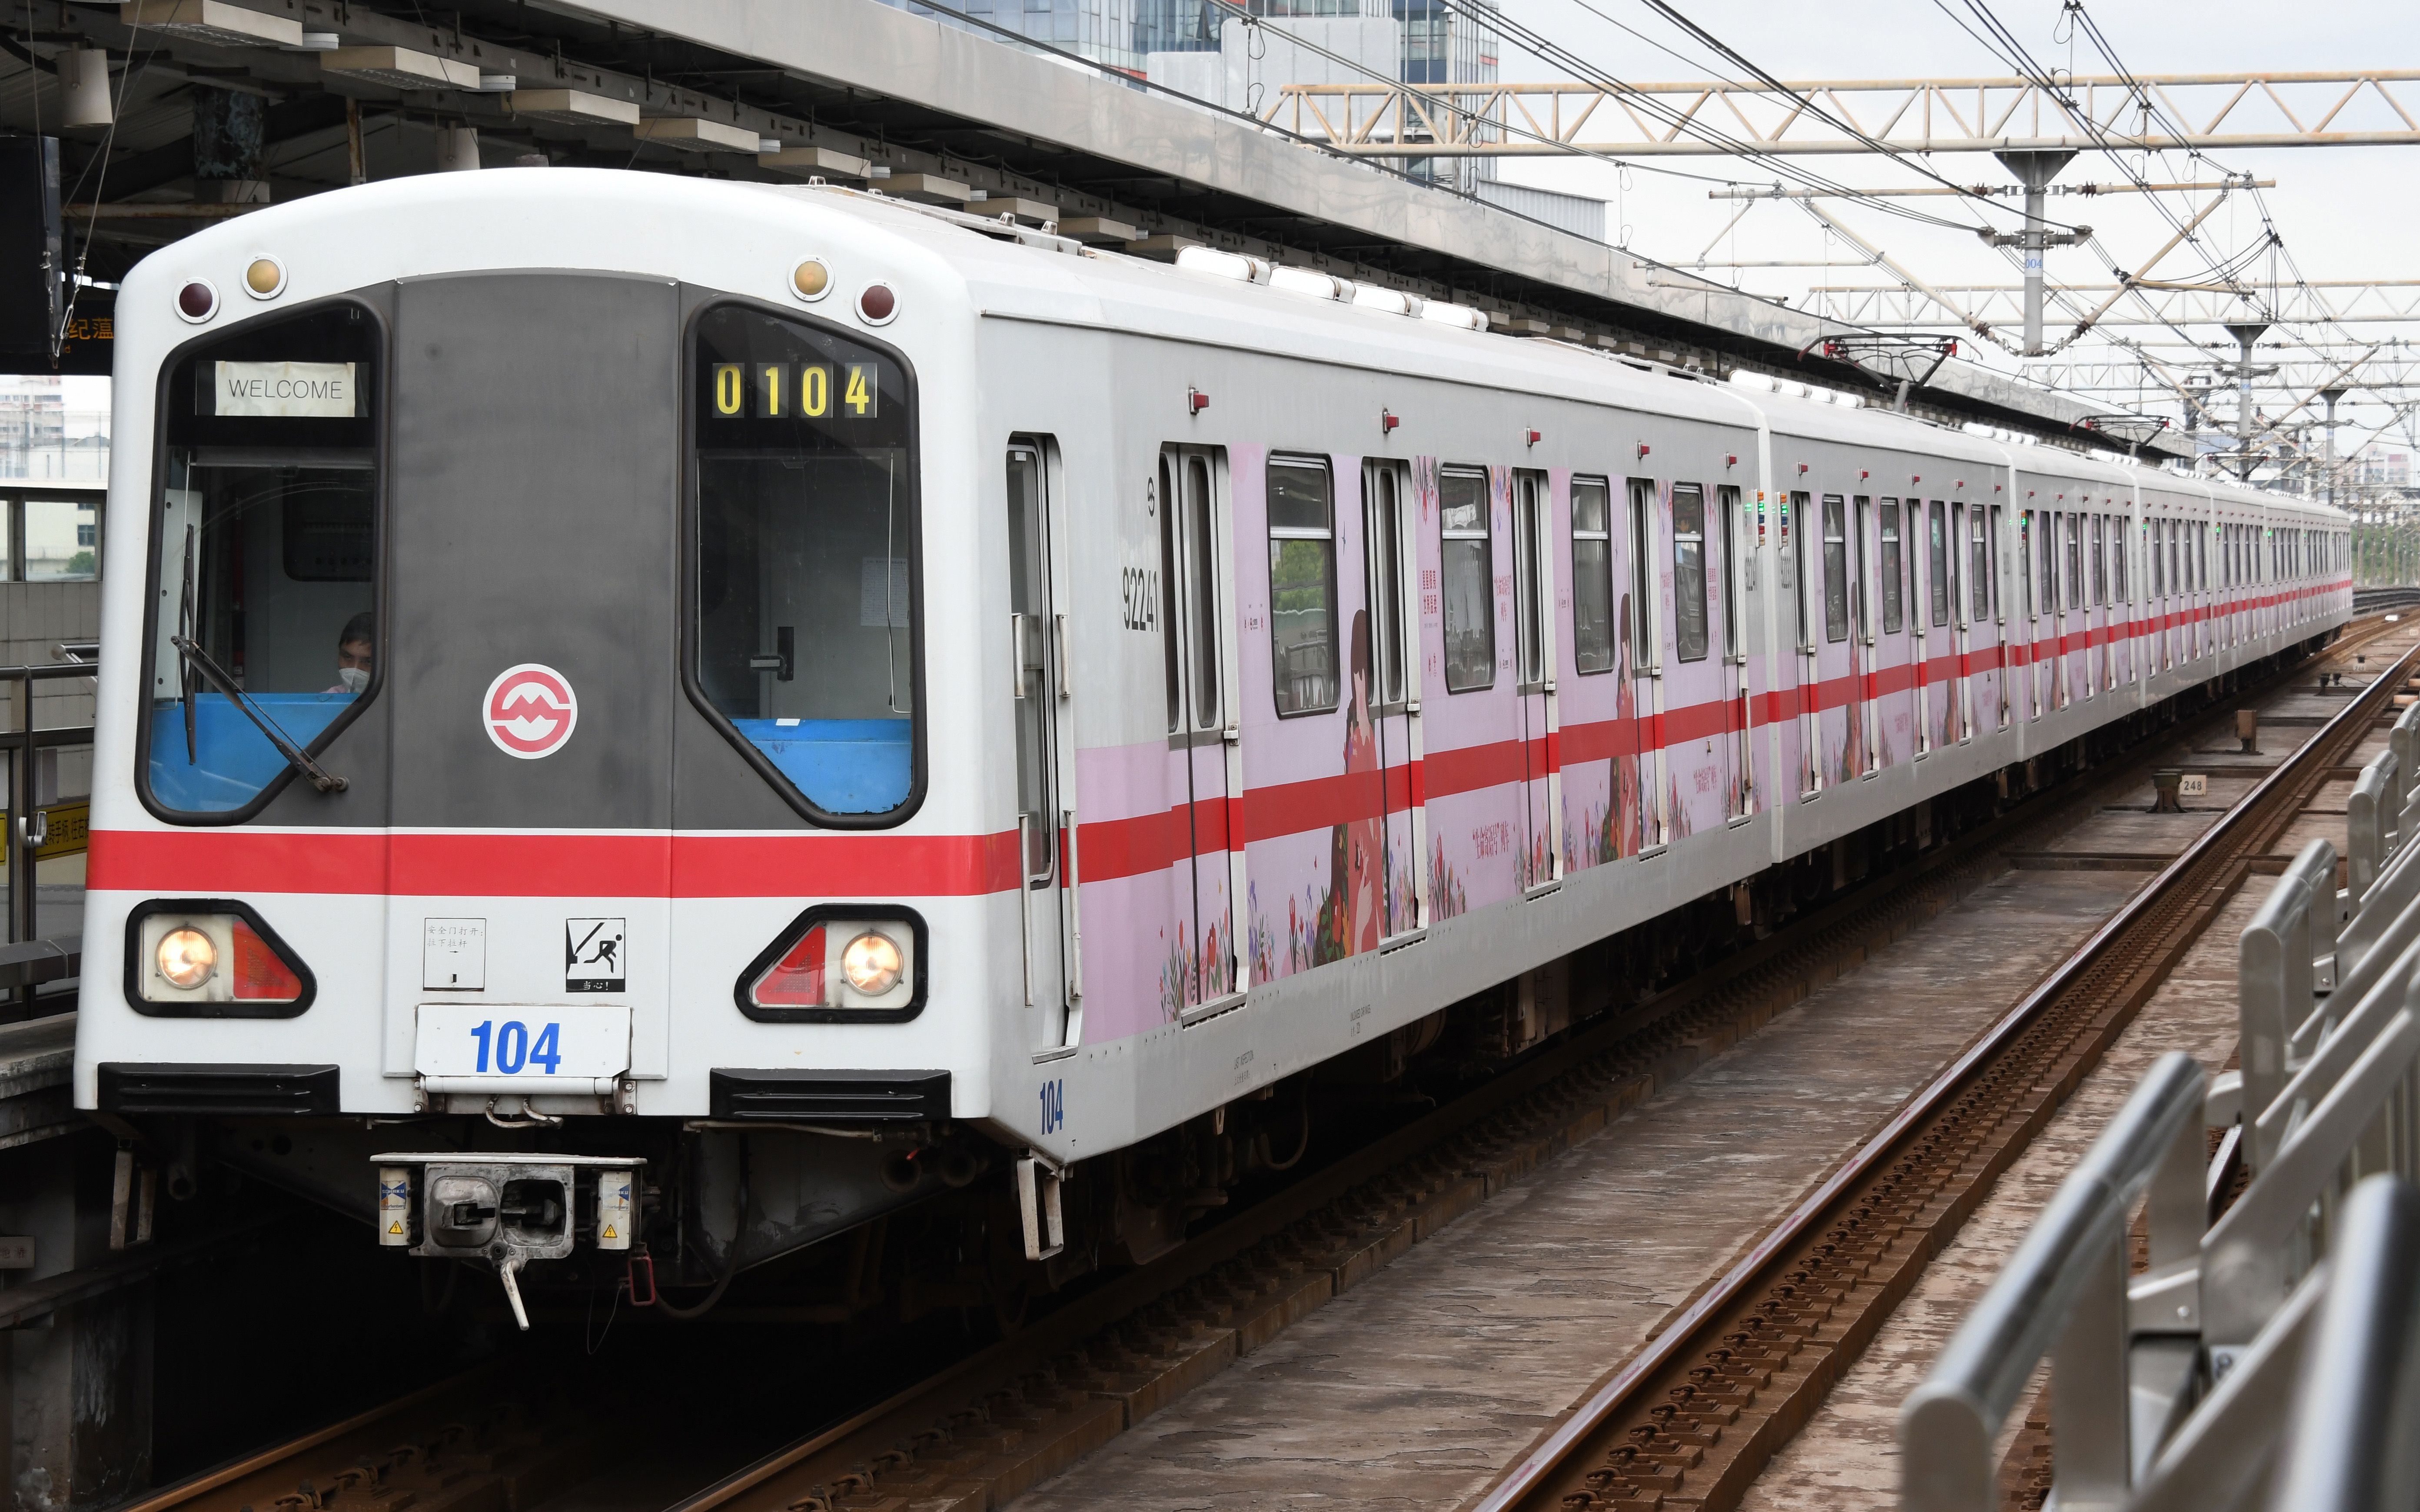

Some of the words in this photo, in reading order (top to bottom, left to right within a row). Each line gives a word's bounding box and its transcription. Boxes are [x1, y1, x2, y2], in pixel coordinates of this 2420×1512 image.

[2025, 259, 2042, 269] 004
[229, 379, 342, 399] WELCOME
[717, 364, 870, 417] 0104
[1123, 566, 1159, 633] 92241
[2184, 780, 2202, 791] 248
[427, 938, 468, 949] 拉下拉杆
[582, 980, 609, 991] 当心！
[470, 1020, 562, 1075] 104
[1040, 1078, 1064, 1135] 104
